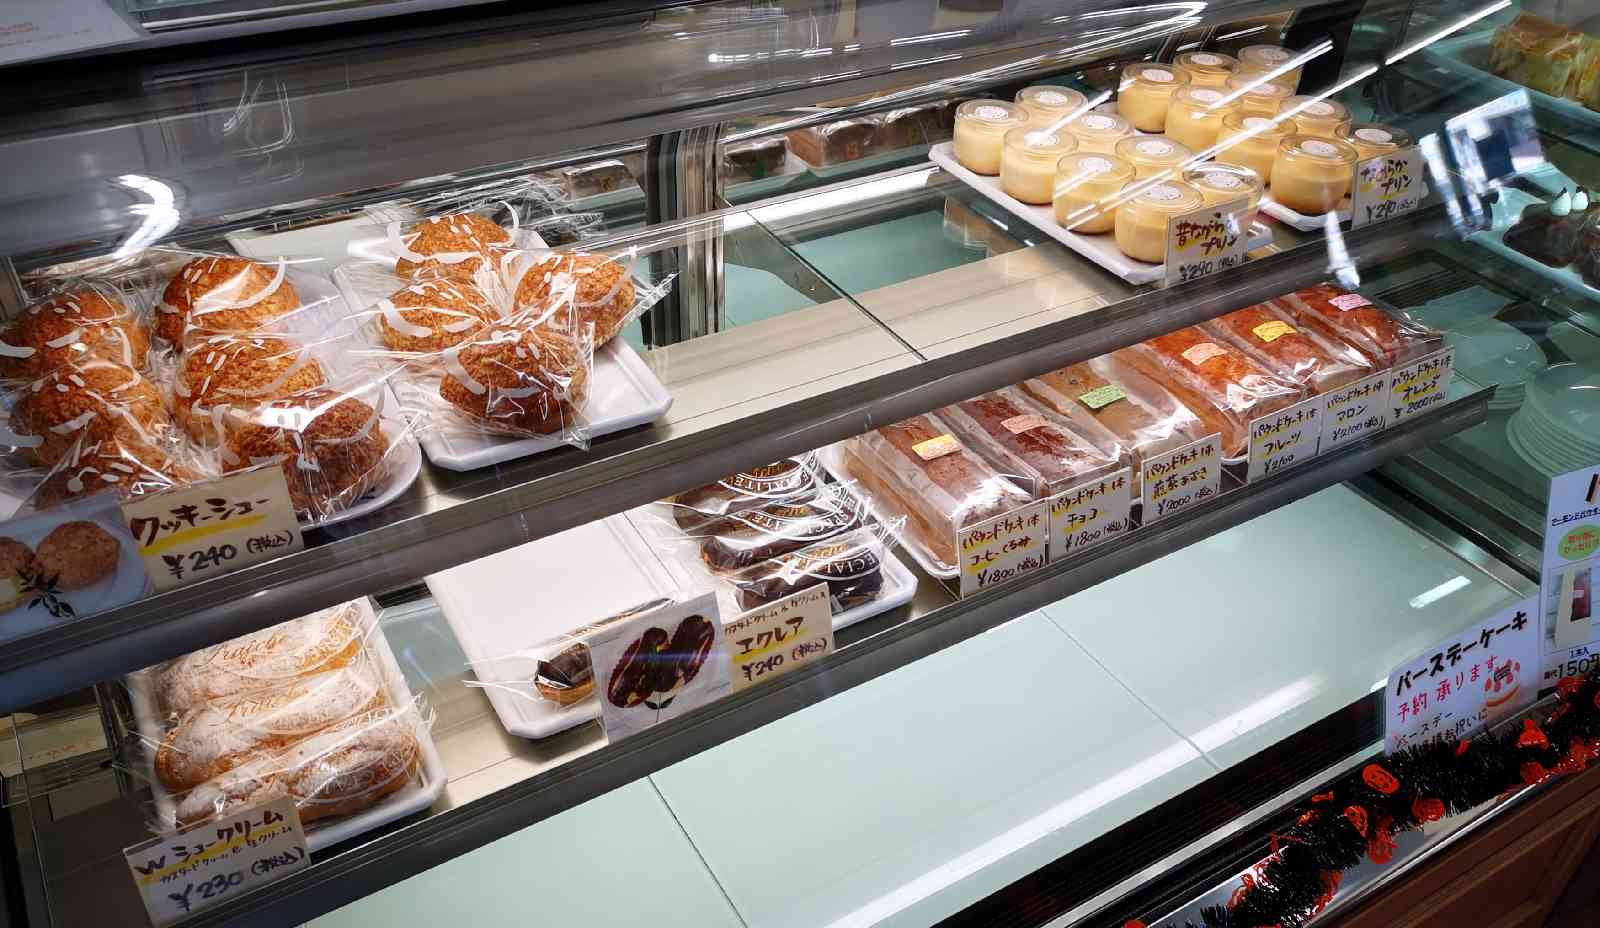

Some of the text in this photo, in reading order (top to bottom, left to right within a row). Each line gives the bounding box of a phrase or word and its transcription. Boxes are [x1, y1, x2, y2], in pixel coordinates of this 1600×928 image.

[1381, 177, 1413, 196] プリン
[1200, 235, 1239, 256] プリン
[1402, 374, 1441, 401] オレンジ
[1337, 405, 1368, 421] マロン
[1264, 431, 1301, 455] フルーツ
[130, 498, 272, 547] クッキーシュー
[1067, 508, 1098, 528] チョコ
[1065, 530, 1101, 550] ¥1800
[162, 530, 294, 580] ¥240 (税込)
[977, 568, 1014, 587] ¥1800
[736, 616, 804, 655] エクレア
[1396, 611, 1528, 696] バースデーケーキ
[741, 654, 784, 681] ¥240
[134, 810, 284, 875] W シュークリーム
[168, 846, 305, 912] ¥230 (税込)
